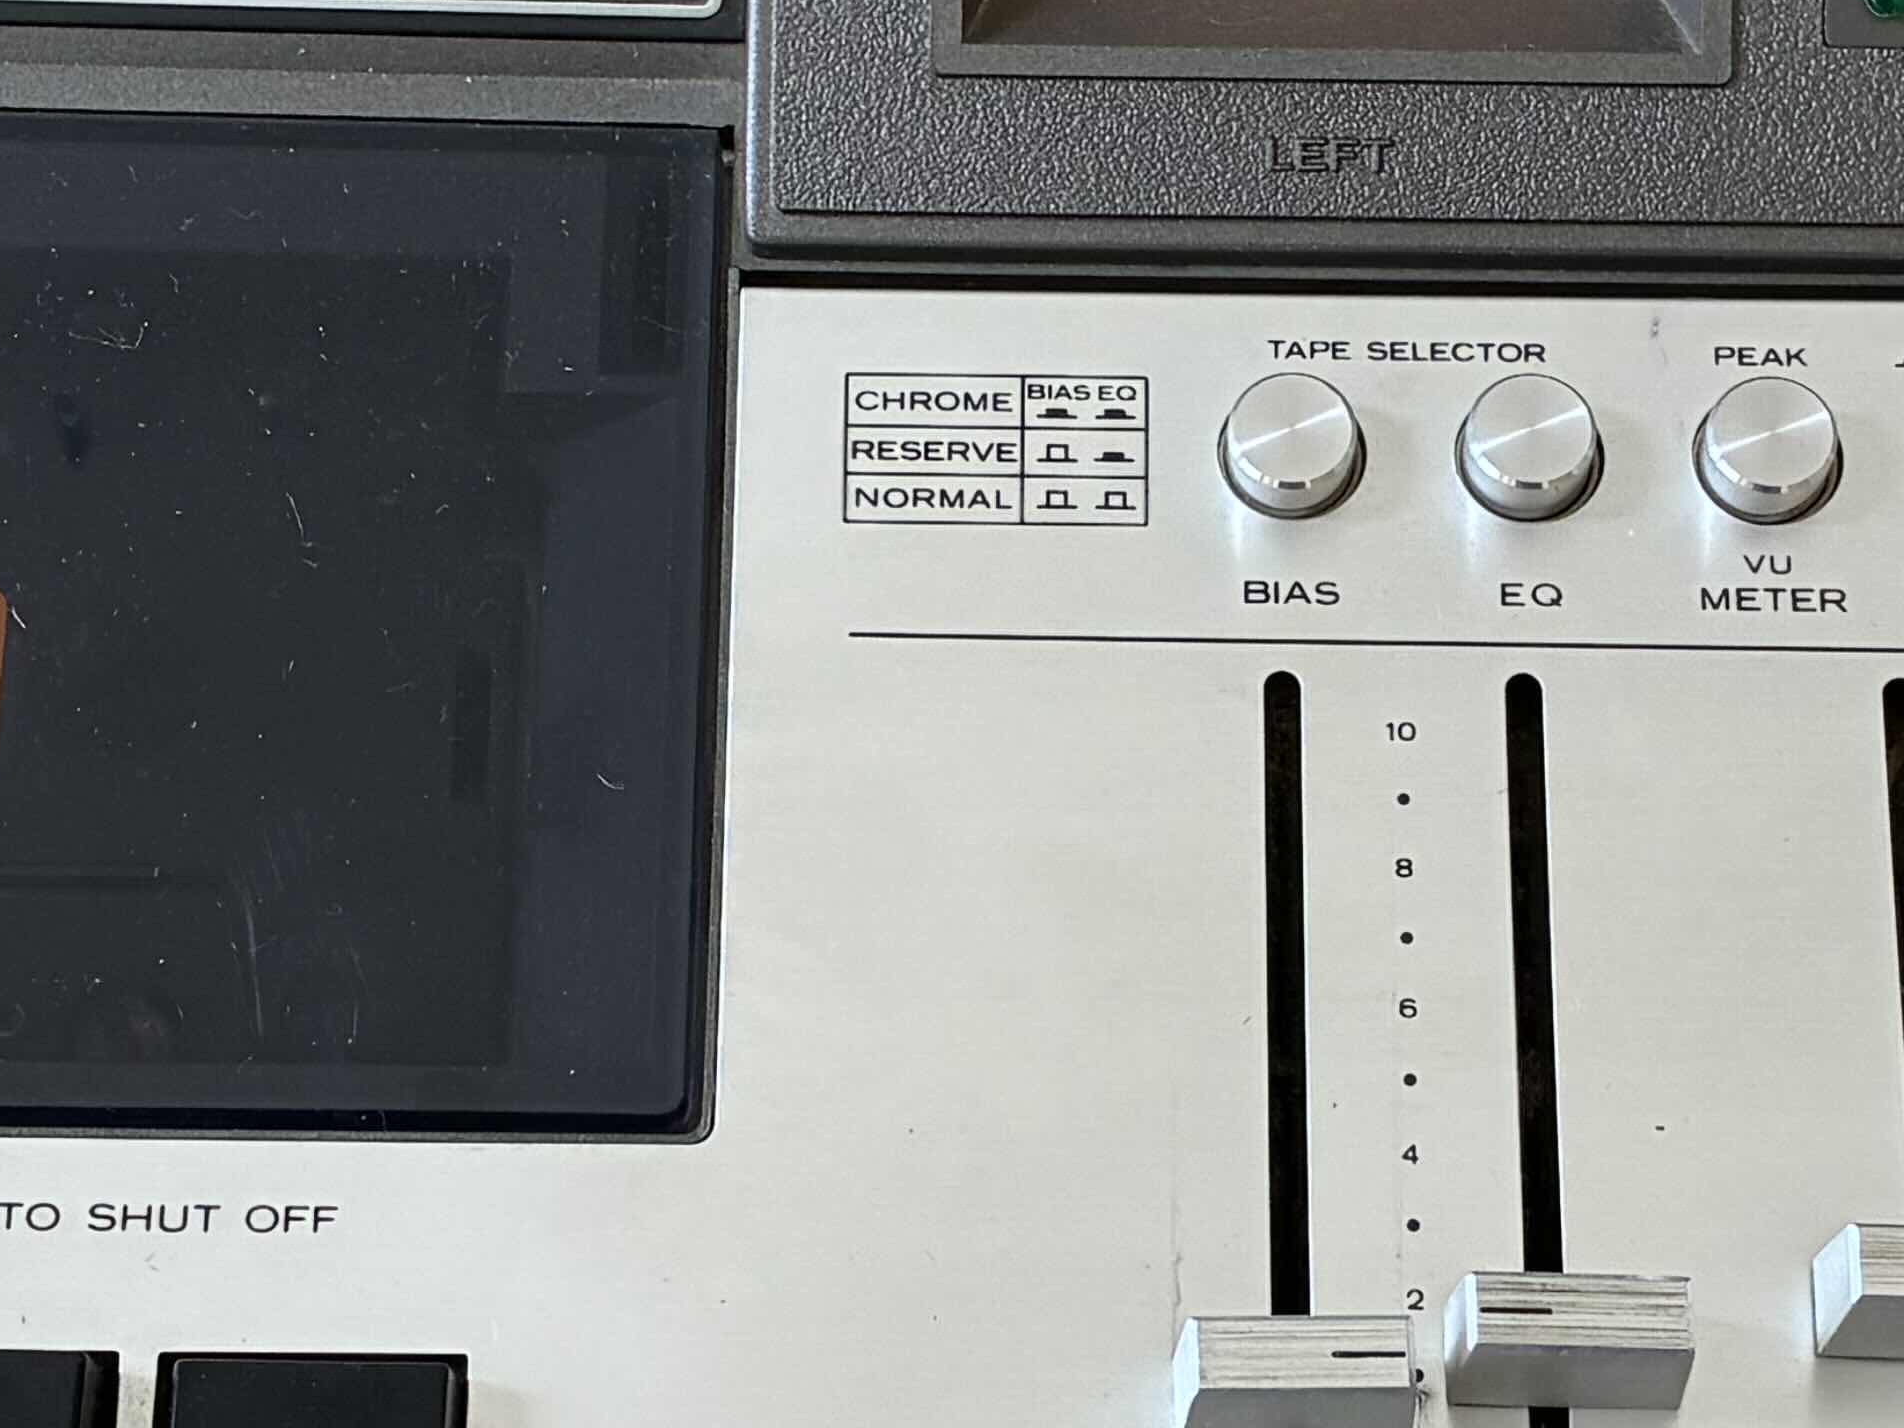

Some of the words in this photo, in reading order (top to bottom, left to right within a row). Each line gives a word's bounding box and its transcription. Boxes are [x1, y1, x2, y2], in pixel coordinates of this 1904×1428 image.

[1266, 136, 1396, 172] LEFT
[1267, 339, 1351, 361] TAPE
[1367, 341, 1546, 363] SELECTOR
[1714, 346, 1808, 367] PEAK
[855, 390, 1013, 413] CHROME
[1027, 383, 1091, 401] BIAS
[1098, 385, 1137, 402] EQ
[851, 440, 1018, 463] RESERVE
[855, 487, 1013, 510] NORMAL
[1743, 554, 1792, 575] VU
[1243, 580, 1340, 606] BIAS
[1500, 582, 1563, 607] EQ
[1700, 587, 1848, 613] METER
[1386, 722, 1417, 742] 10
[1395, 858, 1413, 878] 8
[1399, 998, 1418, 1019] 6
[1401, 1144, 1419, 1165] 4
[87, 1203, 221, 1233] SHUT
[245, 1204, 339, 1234] OFF
[1406, 1288, 1425, 1311] 2
